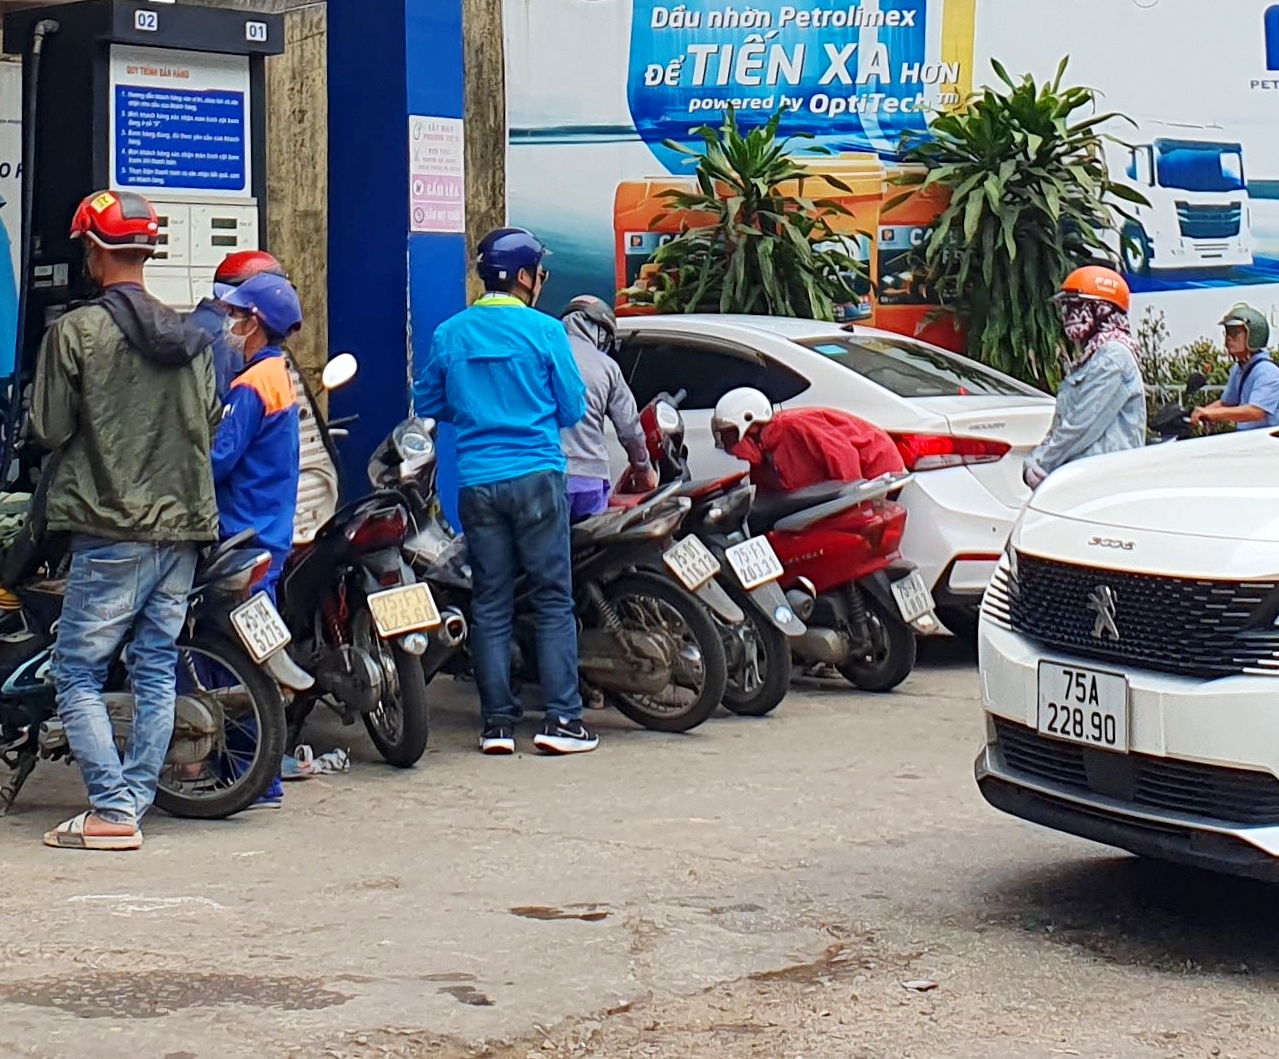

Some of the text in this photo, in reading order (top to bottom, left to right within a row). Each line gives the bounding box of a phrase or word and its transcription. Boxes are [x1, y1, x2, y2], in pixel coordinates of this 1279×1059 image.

[137, 13, 265, 39] 02 01
[650, 5, 917, 30] Dầu nhờn Petrolimex
[644, 30, 961, 87] ĐỂ TIẾN XA HƠN
[688, 94, 774, 112] powered
[779, 94, 804, 113] by
[1063, 670, 1099, 707] 75A
[1047, 702, 1116, 745] 228.90
